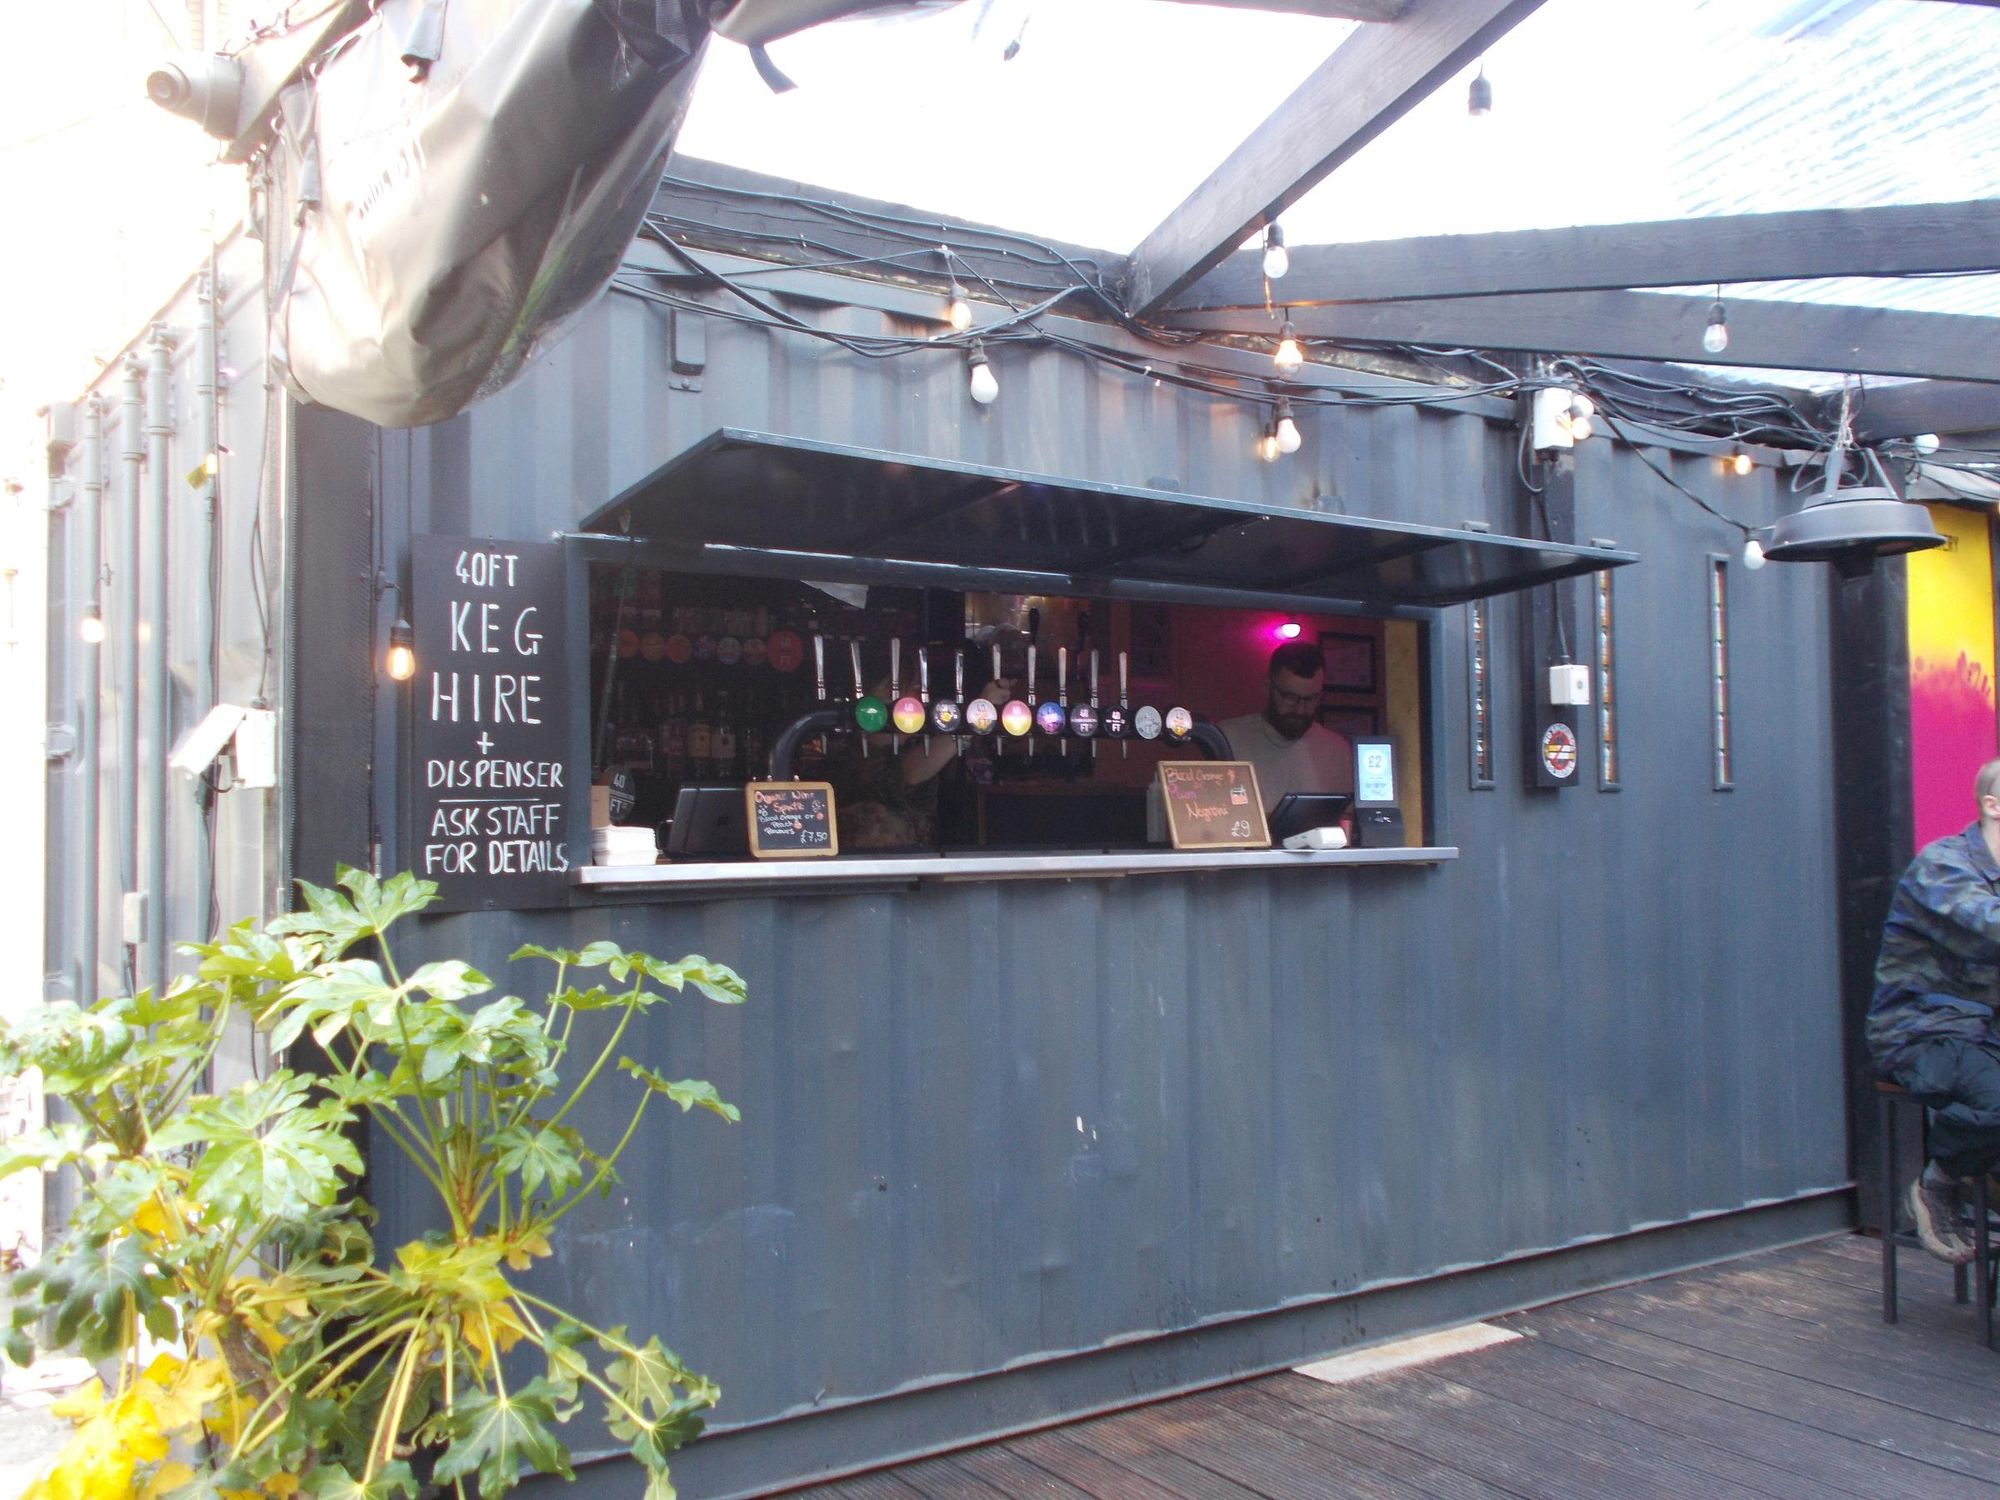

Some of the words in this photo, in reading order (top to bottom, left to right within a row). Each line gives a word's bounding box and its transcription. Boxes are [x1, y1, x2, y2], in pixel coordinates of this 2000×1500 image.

[455, 550, 519, 587] 40FT
[451, 601, 543, 656] KEG
[431, 671, 541, 724] HIRE
[1112, 723, 1121, 732] FT
[427, 759, 564, 788] DISPENSER
[613, 773, 626, 788] 40
[431, 807, 480, 837] ASK
[486, 803, 561, 836] STAFF
[609, 799, 623, 814] FT
[1231, 820, 1251, 838] £9
[425, 841, 477, 875] FOR
[488, 839, 570, 875] DETAILS
